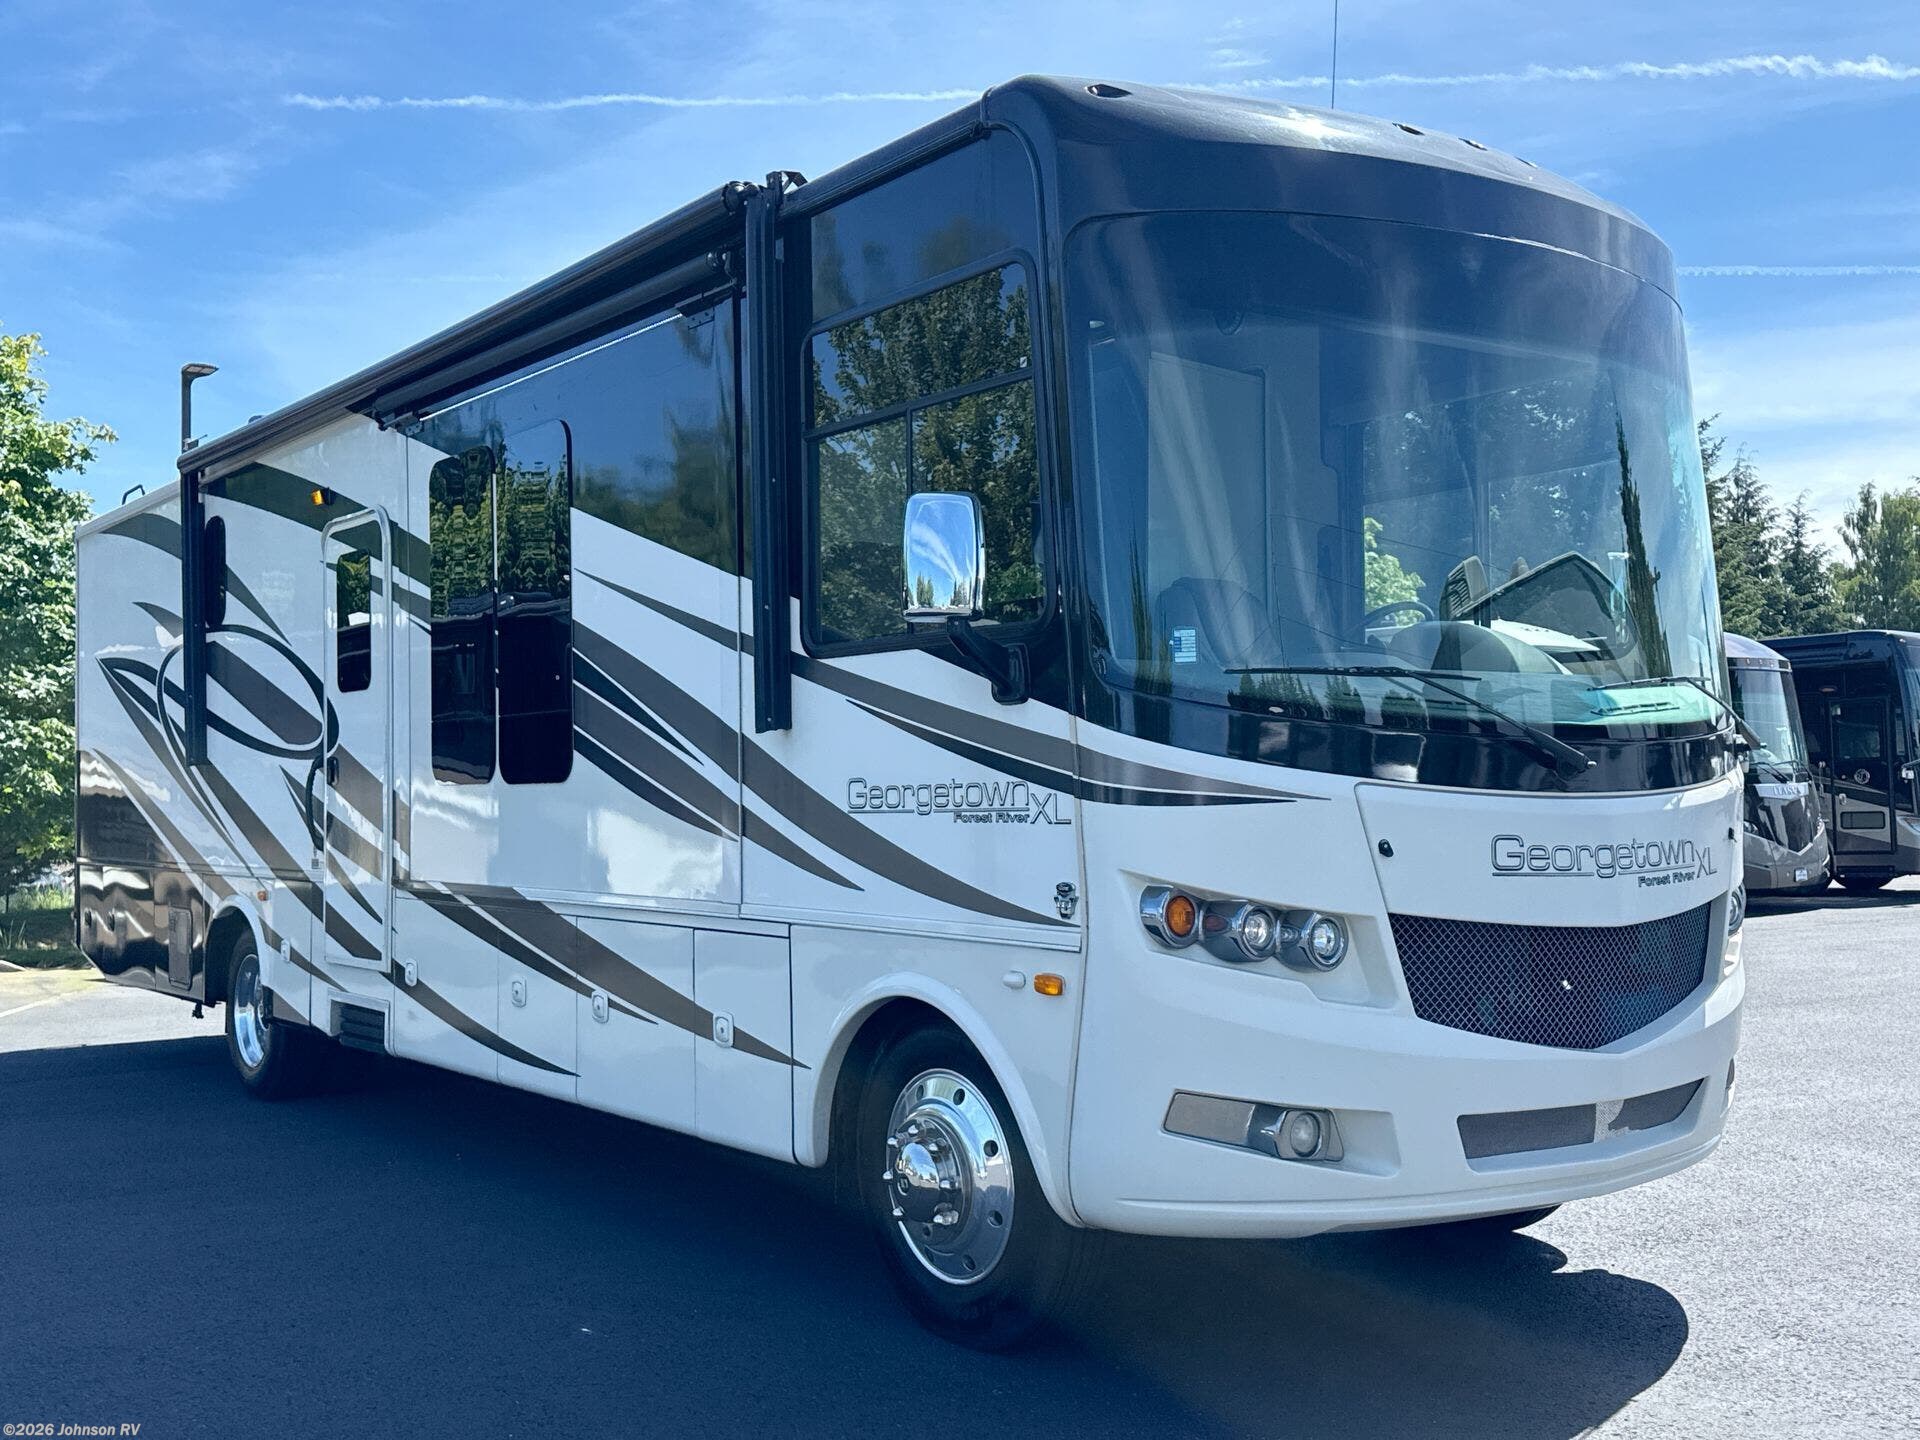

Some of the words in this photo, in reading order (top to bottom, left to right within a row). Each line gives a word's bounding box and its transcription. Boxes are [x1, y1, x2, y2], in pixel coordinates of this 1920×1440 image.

[847, 777, 1030, 816] Georgetown
[1030, 793, 1072, 825] XL
[953, 811, 993, 824] Forest
[995, 811, 1030, 824] River
[1491, 834, 1696, 879] Georgetown
[1695, 846, 1718, 879] XL
[1638, 874, 1671, 888] Forest
[1672, 870, 1695, 884] River
